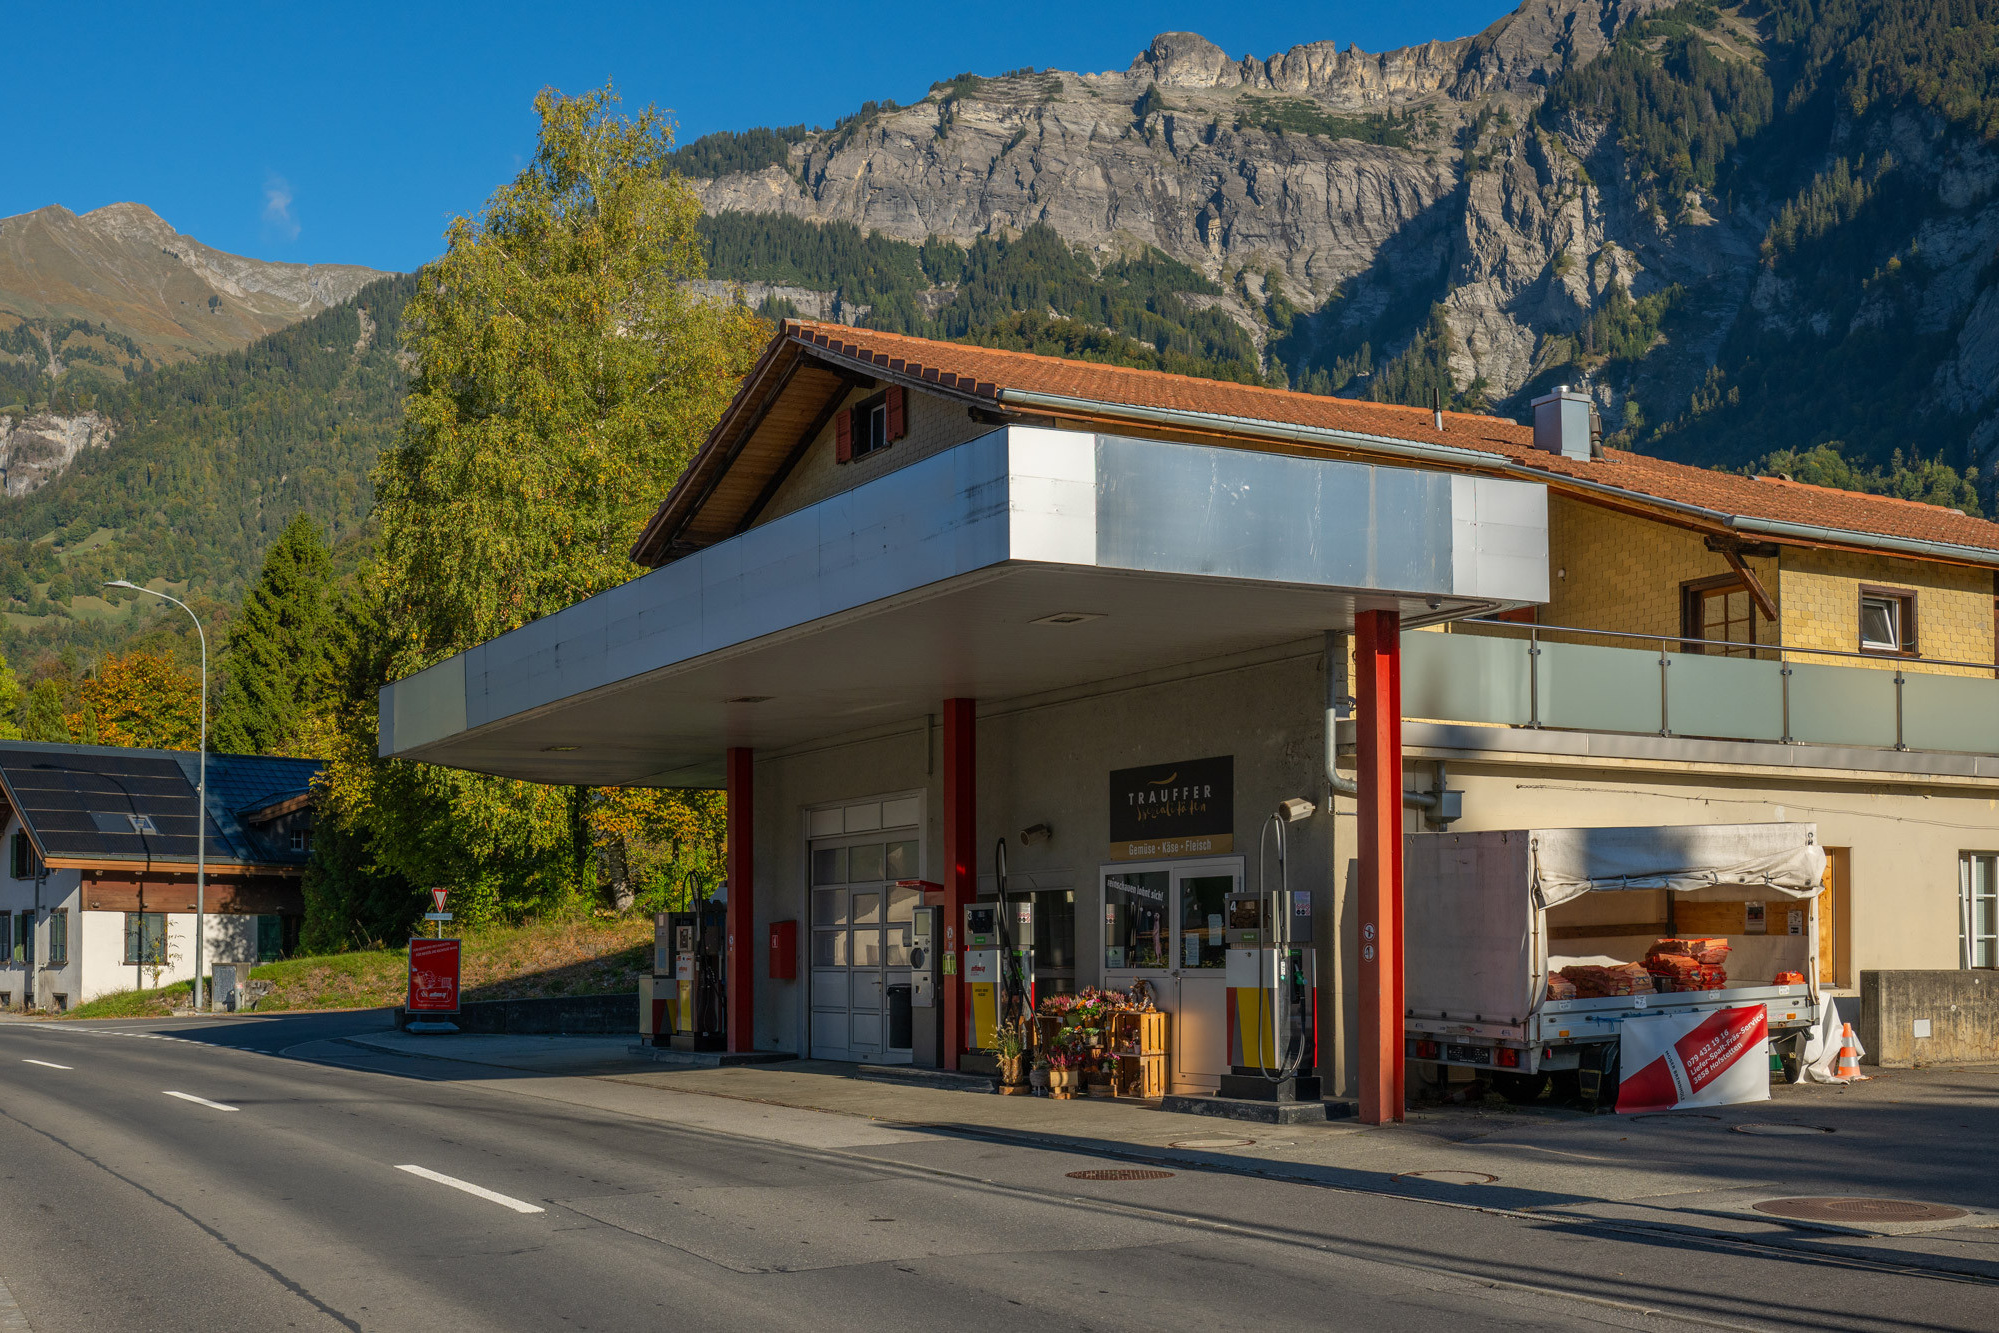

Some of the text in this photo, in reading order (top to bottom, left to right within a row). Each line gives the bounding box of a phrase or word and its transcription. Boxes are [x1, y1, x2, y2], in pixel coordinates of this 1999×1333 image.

[1128, 785, 1211, 805] TRAUFFER
[1128, 839, 1212, 856] Gemüse Käse Fleisch
[1137, 885, 1150, 898] lohnt
[1151, 890, 1164, 901] sich!
[967, 910, 972, 920] 3
[1230, 901, 1237, 912] 4
[1686, 1028, 1729, 1067] 079 432 19 16
[1690, 1013, 1765, 1076] Liefer-Spalt-Fräs-Service
[1693, 1042, 1743, 1085] 3858 Hofstetten
[1665, 1050, 1685, 1101] MOSER BRENNHOLZ
